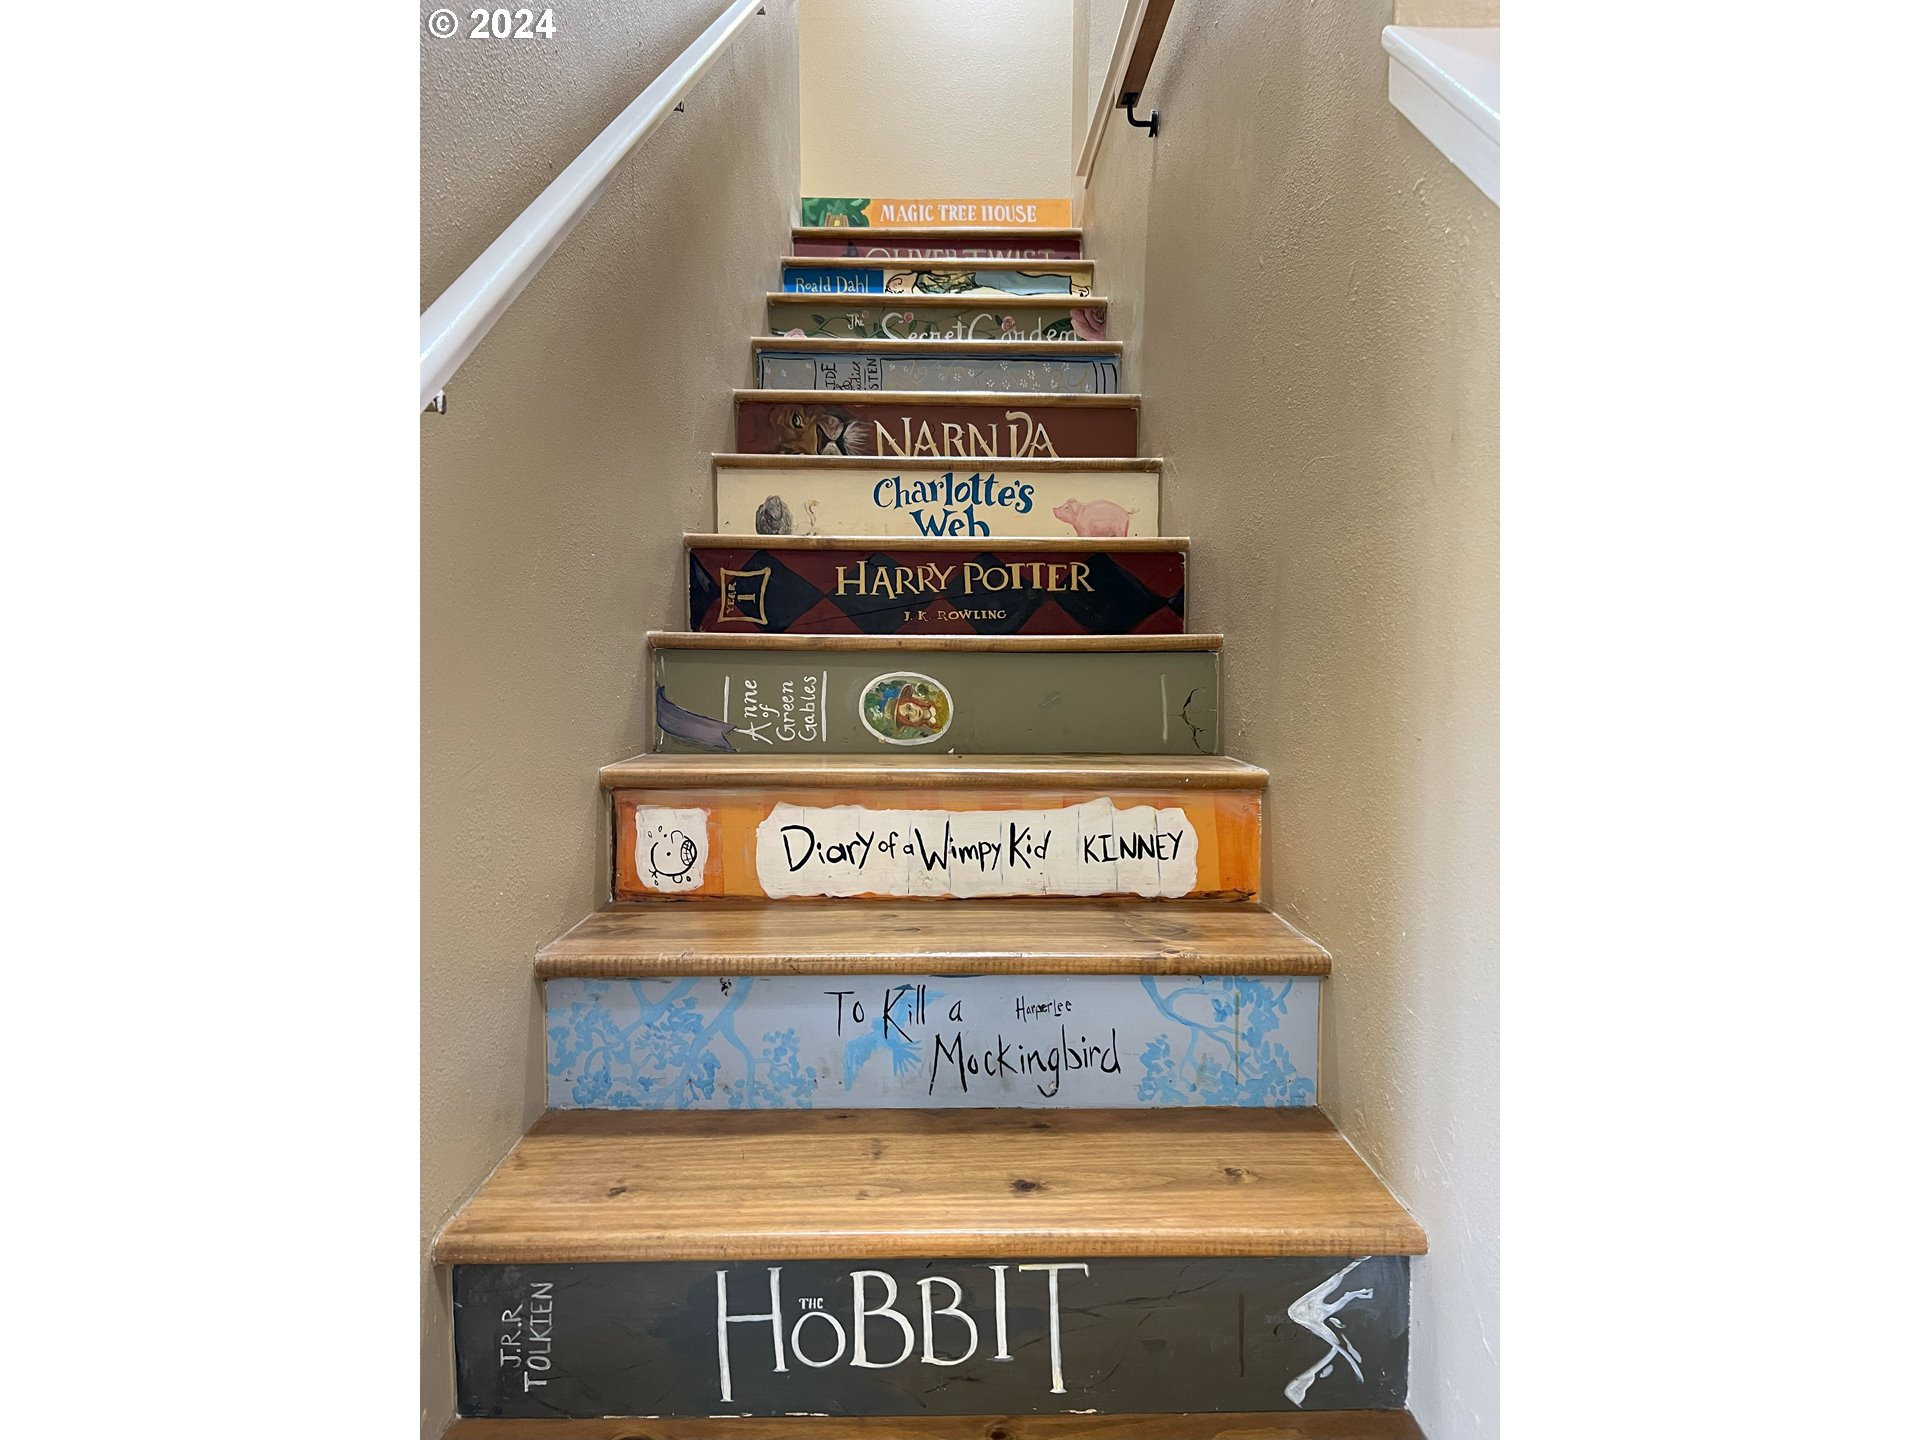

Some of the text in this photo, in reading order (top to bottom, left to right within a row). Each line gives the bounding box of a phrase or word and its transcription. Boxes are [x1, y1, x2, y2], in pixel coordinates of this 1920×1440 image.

[879, 204, 1037, 223] MAGIC TREE HOUSE
[795, 272, 869, 293] Roald Dahl
[846, 312, 865, 330] The
[873, 472, 1035, 514] Charlotte's
[909, 504, 990, 537] Web
[726, 581, 737, 614] YEAR
[737, 592, 756, 604] 1
[835, 560, 1095, 599] HARRY POTTER
[937, 609, 1007, 621] ROWLING
[734, 679, 774, 745] Anne
[759, 703, 780, 718] of
[775, 680, 796, 742] Green
[797, 675, 818, 742] Gables
[780, 820, 1184, 872] Diary of a Wimpy Kid KINNEY
[824, 984, 964, 1043] To Kill a
[929, 1023, 1121, 1098] Mockingbird
[523, 1282, 554, 1393] TOLKIEN
